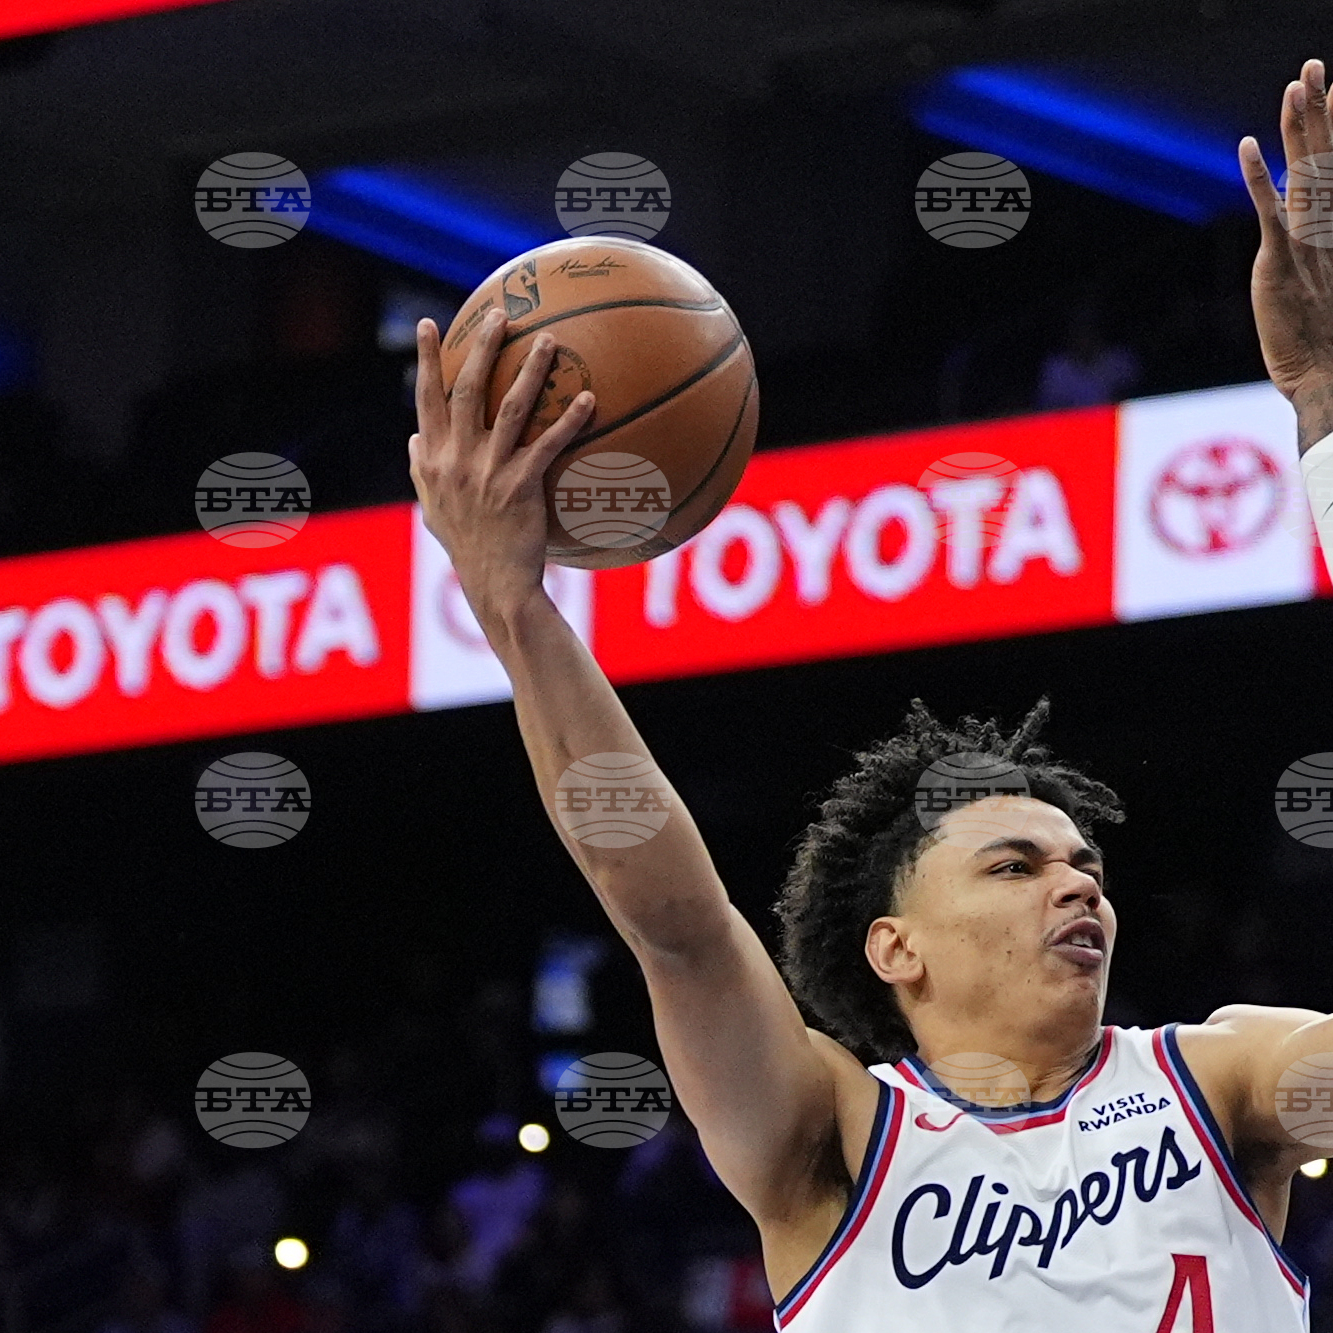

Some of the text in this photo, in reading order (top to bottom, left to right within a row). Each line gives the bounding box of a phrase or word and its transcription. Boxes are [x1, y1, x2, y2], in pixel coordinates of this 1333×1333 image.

[1078, 1096, 1172, 1133] RWANDA
[1092, 1091, 1146, 1117] VISIT
[890, 1126, 1202, 1290] Clippers
